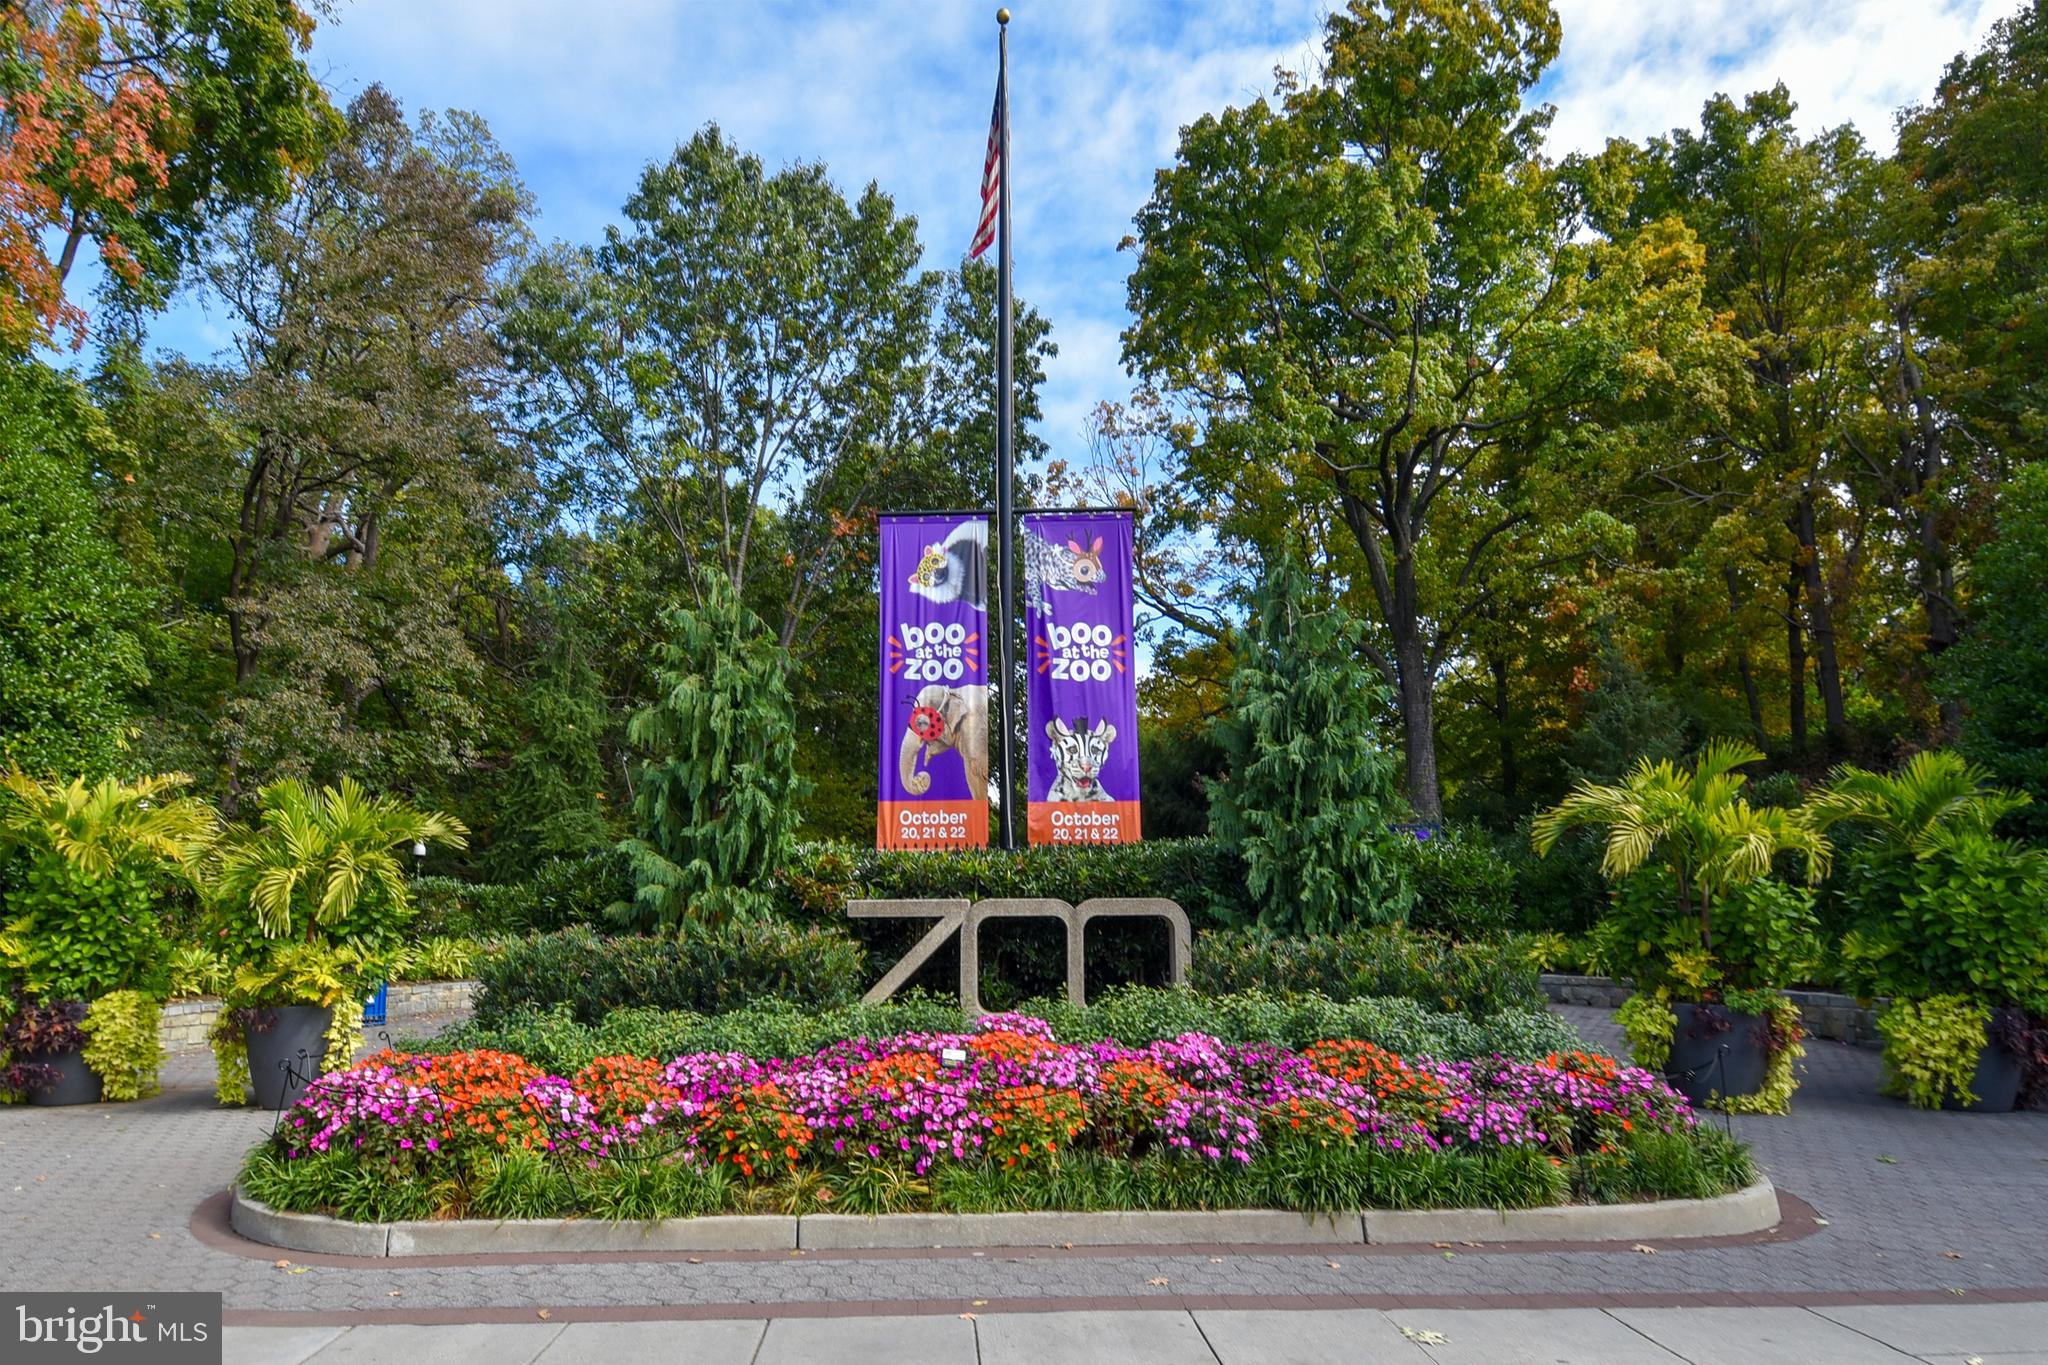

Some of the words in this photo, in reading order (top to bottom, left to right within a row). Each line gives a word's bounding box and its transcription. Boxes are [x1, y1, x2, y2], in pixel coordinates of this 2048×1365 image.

[900, 622, 966, 651] boo
[1046, 622, 1113, 650] boo
[915, 645, 933, 659] at
[934, 643, 962, 658] the
[1062, 645, 1080, 659] at
[1081, 643, 1110, 659] the
[899, 809, 968, 825] October
[1051, 810, 1120, 826] October
[901, 826, 920, 840] 20,
[922, 826, 936, 838] 21
[938, 826, 947, 838] &
[950, 826, 966, 838] 22
[1052, 828, 1072, 841] 20,
[1074, 828, 1088, 840] 21
[1090, 828, 1100, 840] &
[1102, 827, 1118, 840] 22
